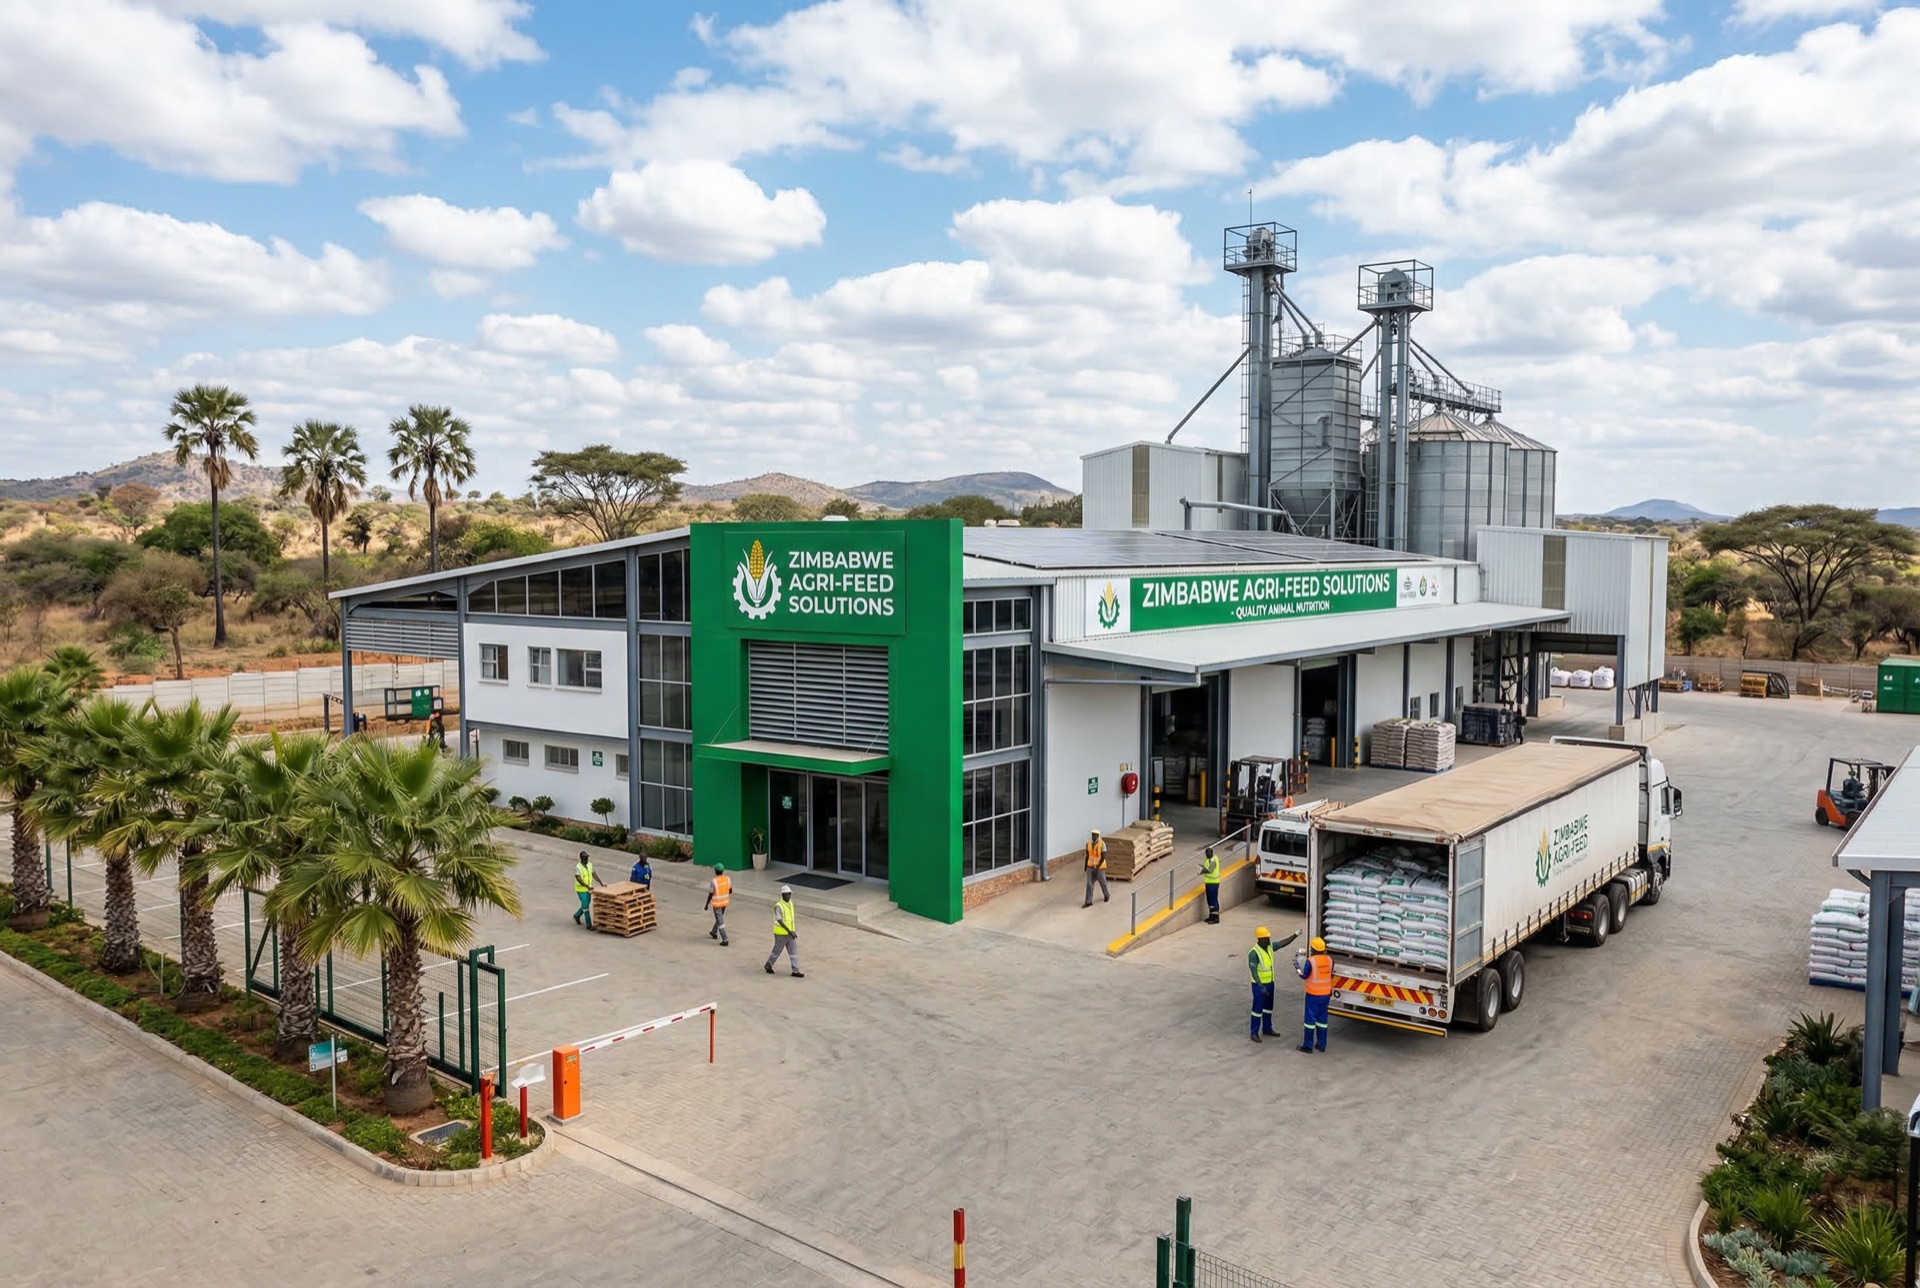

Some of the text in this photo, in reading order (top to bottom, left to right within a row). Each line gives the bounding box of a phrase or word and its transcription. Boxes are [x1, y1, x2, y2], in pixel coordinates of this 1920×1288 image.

[788, 551, 894, 569] ZIMBABWE
[788, 573, 894, 593] AGRI-FEED
[1142, 573, 1390, 608] ZIMBABWE AGRI-FEED SOLUTIONS
[788, 596, 894, 616] SOLUTIONS
[1236, 600, 1330, 620] QUALITY ANIMAL NUTRITION
